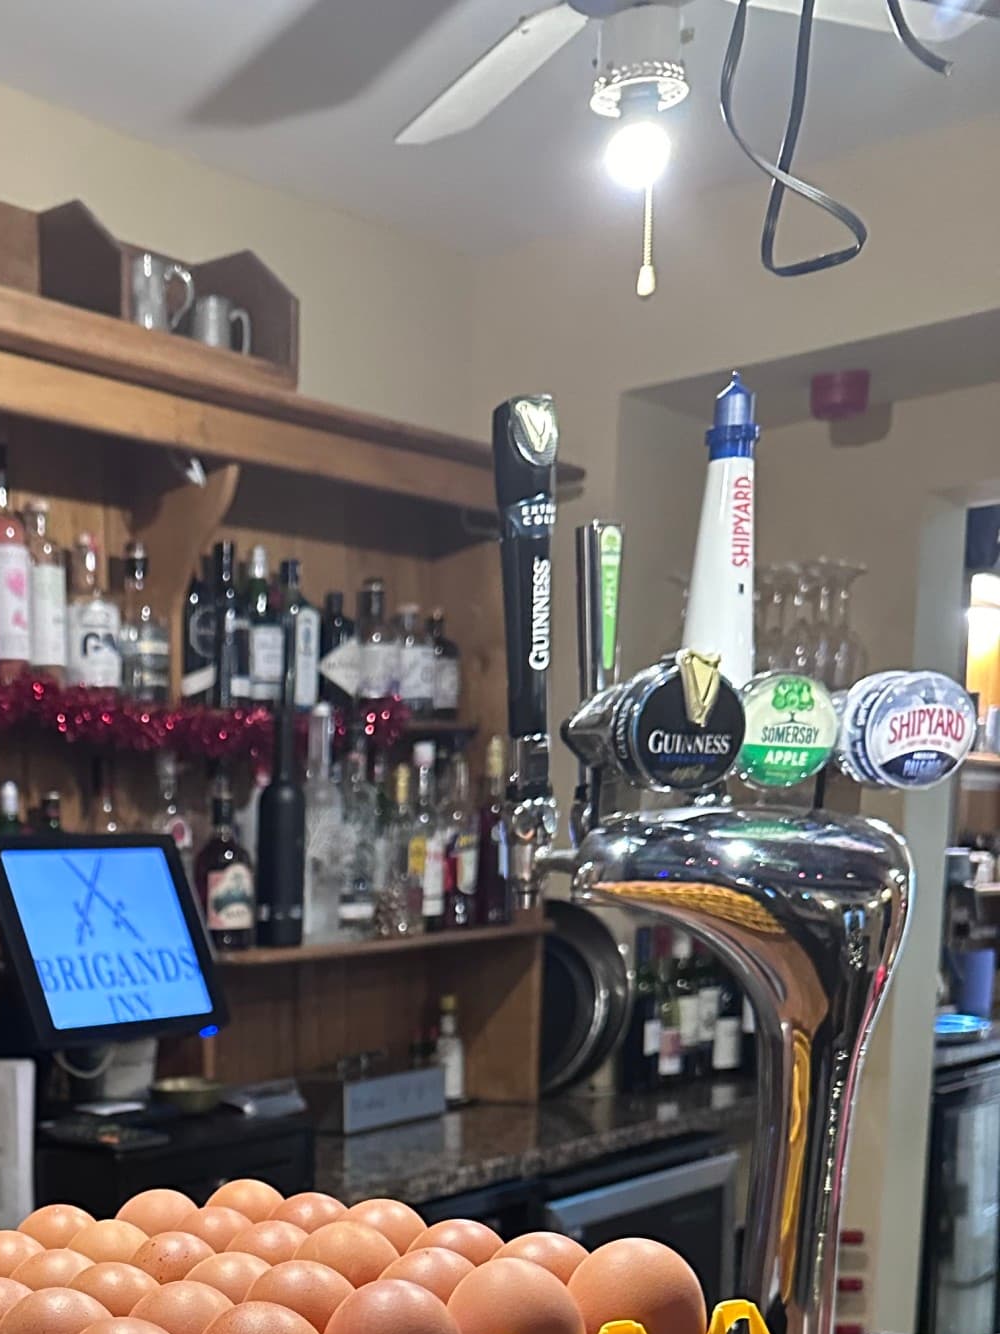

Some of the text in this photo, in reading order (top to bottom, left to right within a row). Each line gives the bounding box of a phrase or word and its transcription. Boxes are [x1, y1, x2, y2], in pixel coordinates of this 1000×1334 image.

[731, 476, 753, 568] SHIPYARD
[528, 556, 550, 670] GUINNESS
[648, 729, 731, 755] GUINNESS
[761, 725, 820, 744] SOMERSBY
[888, 707, 966, 745] SHIPYARD
[764, 751, 809, 767] APPLE
[34, 946, 202, 994] BRIGANDS
[106, 991, 153, 1023] INN
